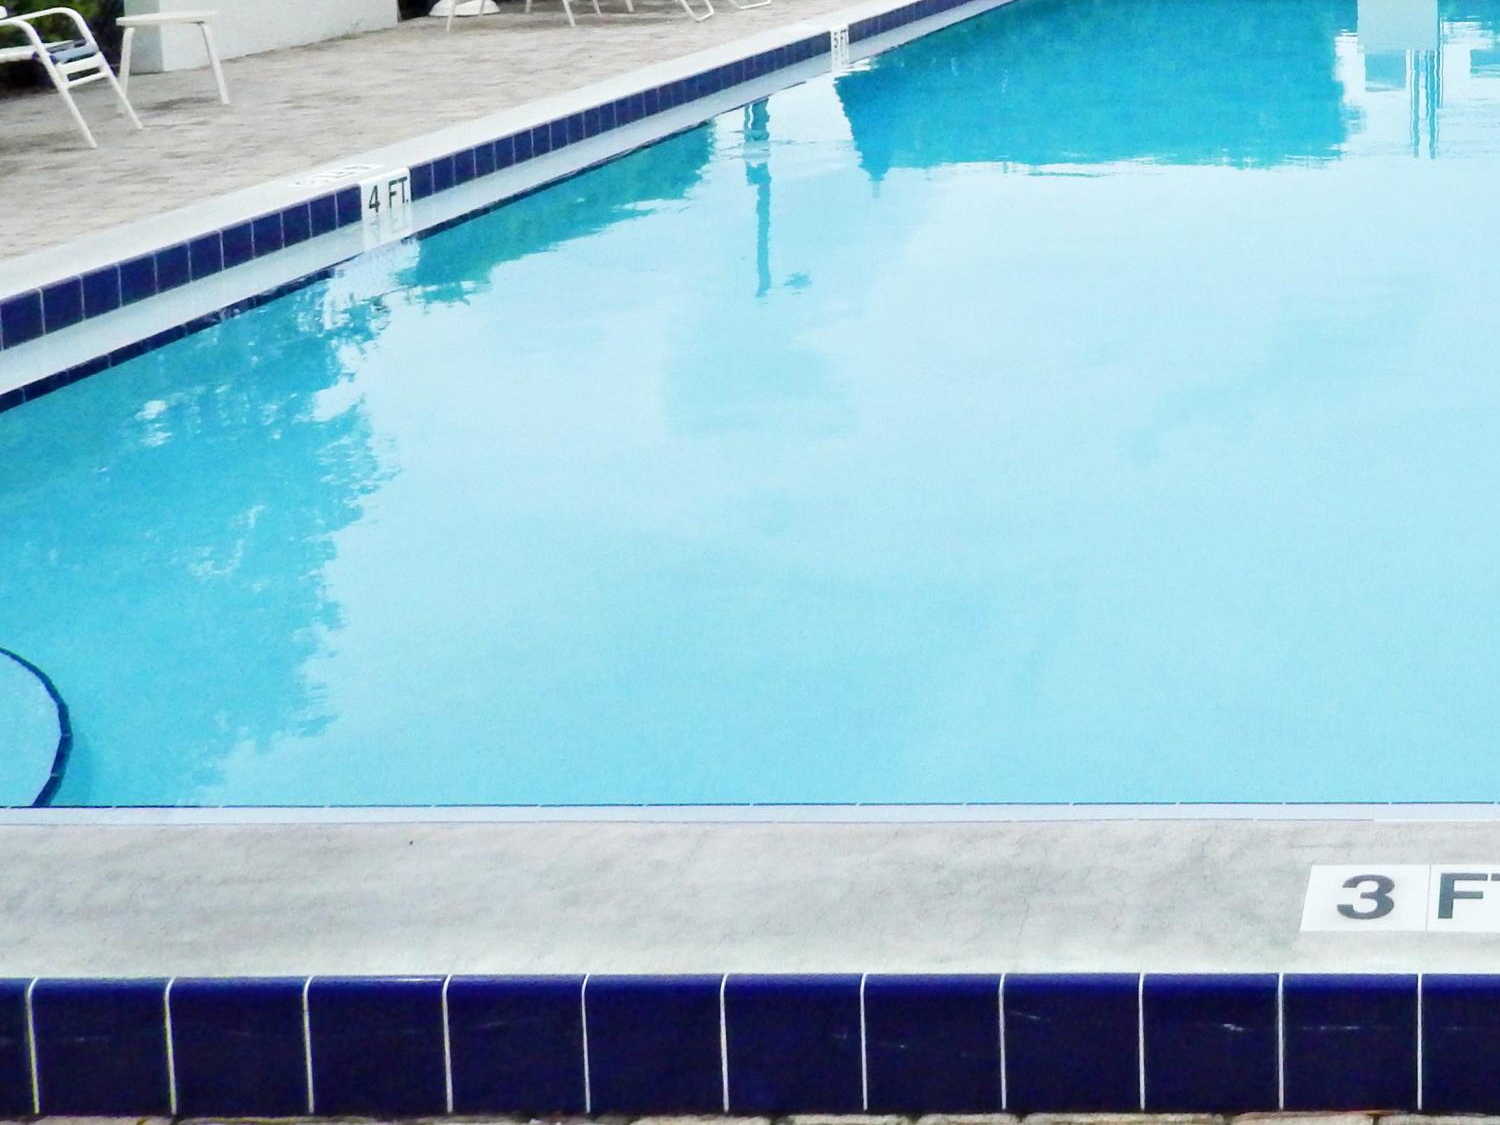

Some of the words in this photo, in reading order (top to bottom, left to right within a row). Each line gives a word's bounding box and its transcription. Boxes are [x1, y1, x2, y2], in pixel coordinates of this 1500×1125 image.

[368, 184, 381, 213] 4
[388, 176, 409, 208] FT.
[1337, 874, 1396, 920] 3
